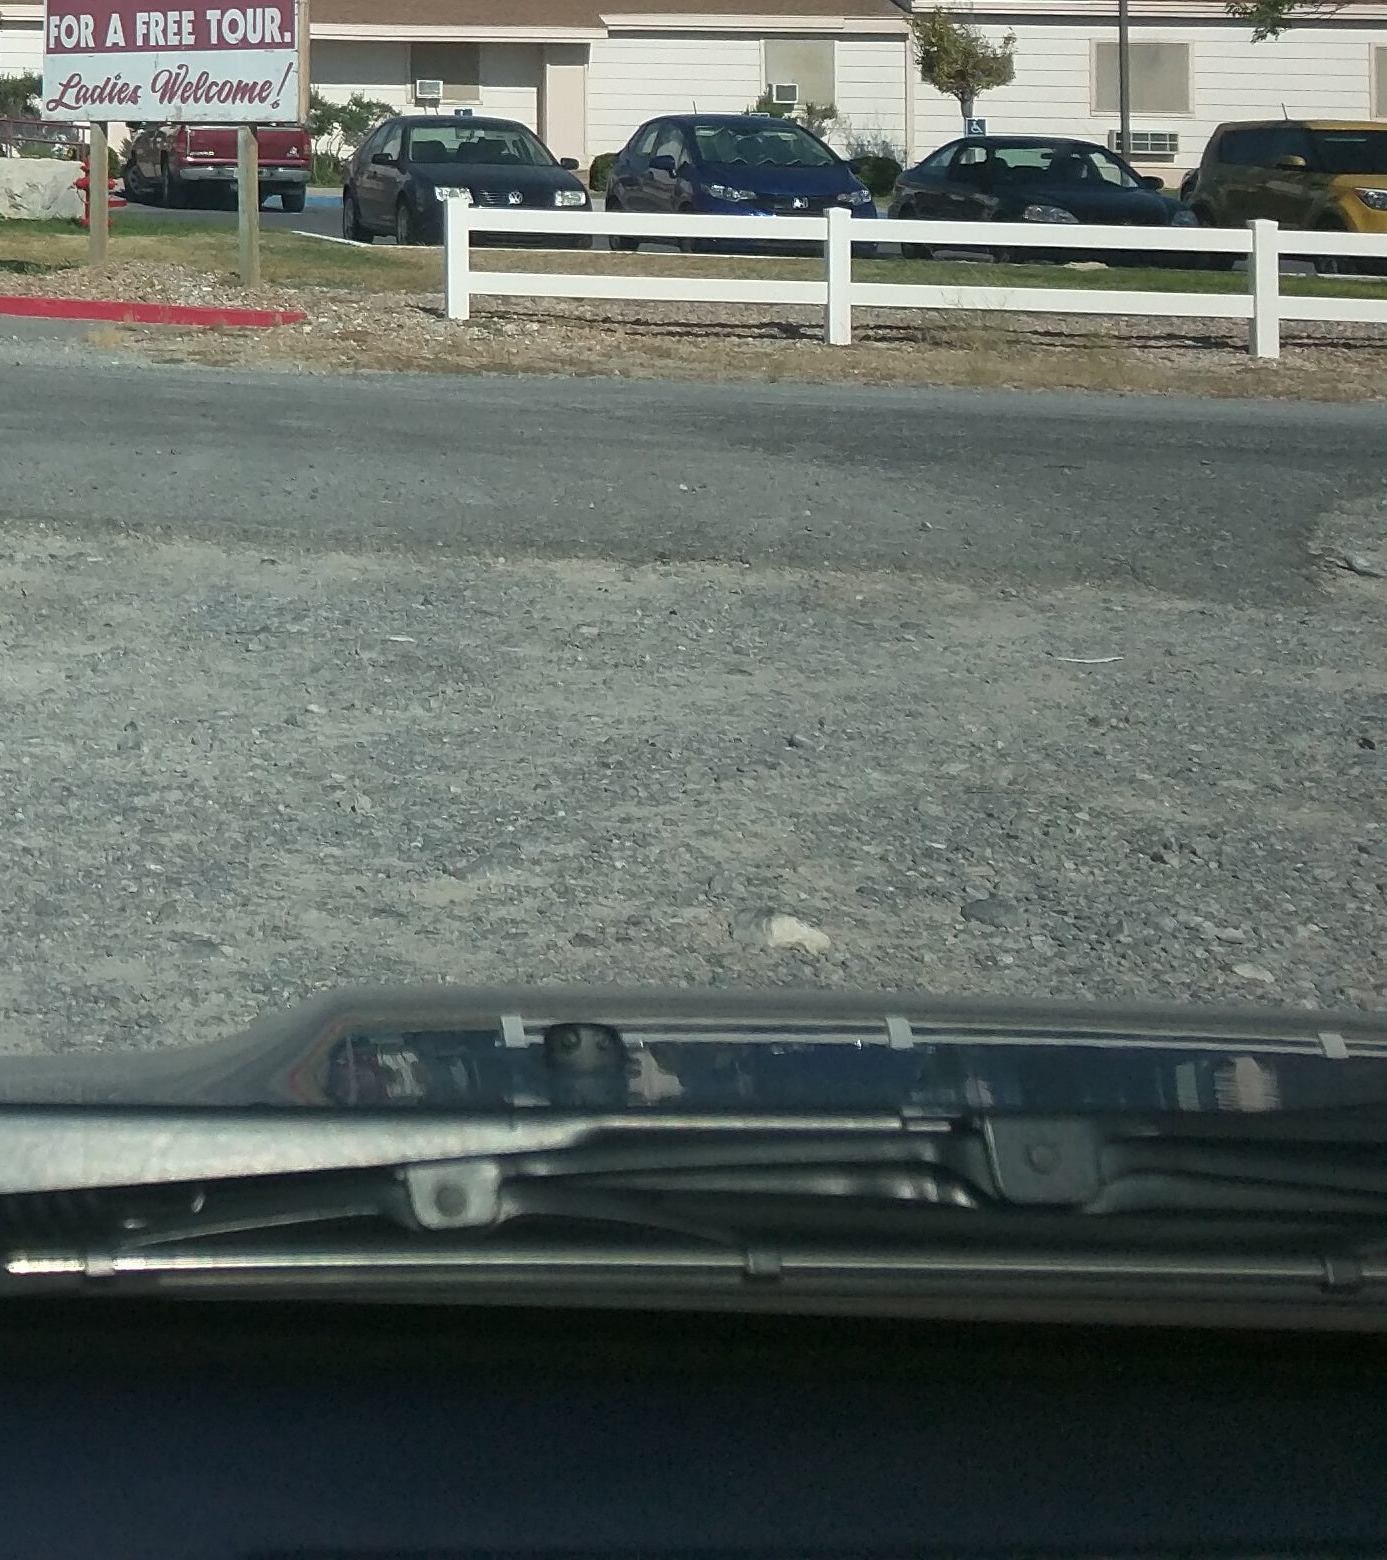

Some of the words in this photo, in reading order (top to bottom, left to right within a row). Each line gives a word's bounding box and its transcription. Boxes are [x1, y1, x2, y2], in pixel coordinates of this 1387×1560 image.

[48, 13, 96, 50] FOR
[105, 13, 126, 48] A
[136, 10, 196, 47] FREE
[206, 7, 292, 45] TOUR.
[46, 71, 142, 112] Ladies
[151, 61, 294, 110] Welcome!
